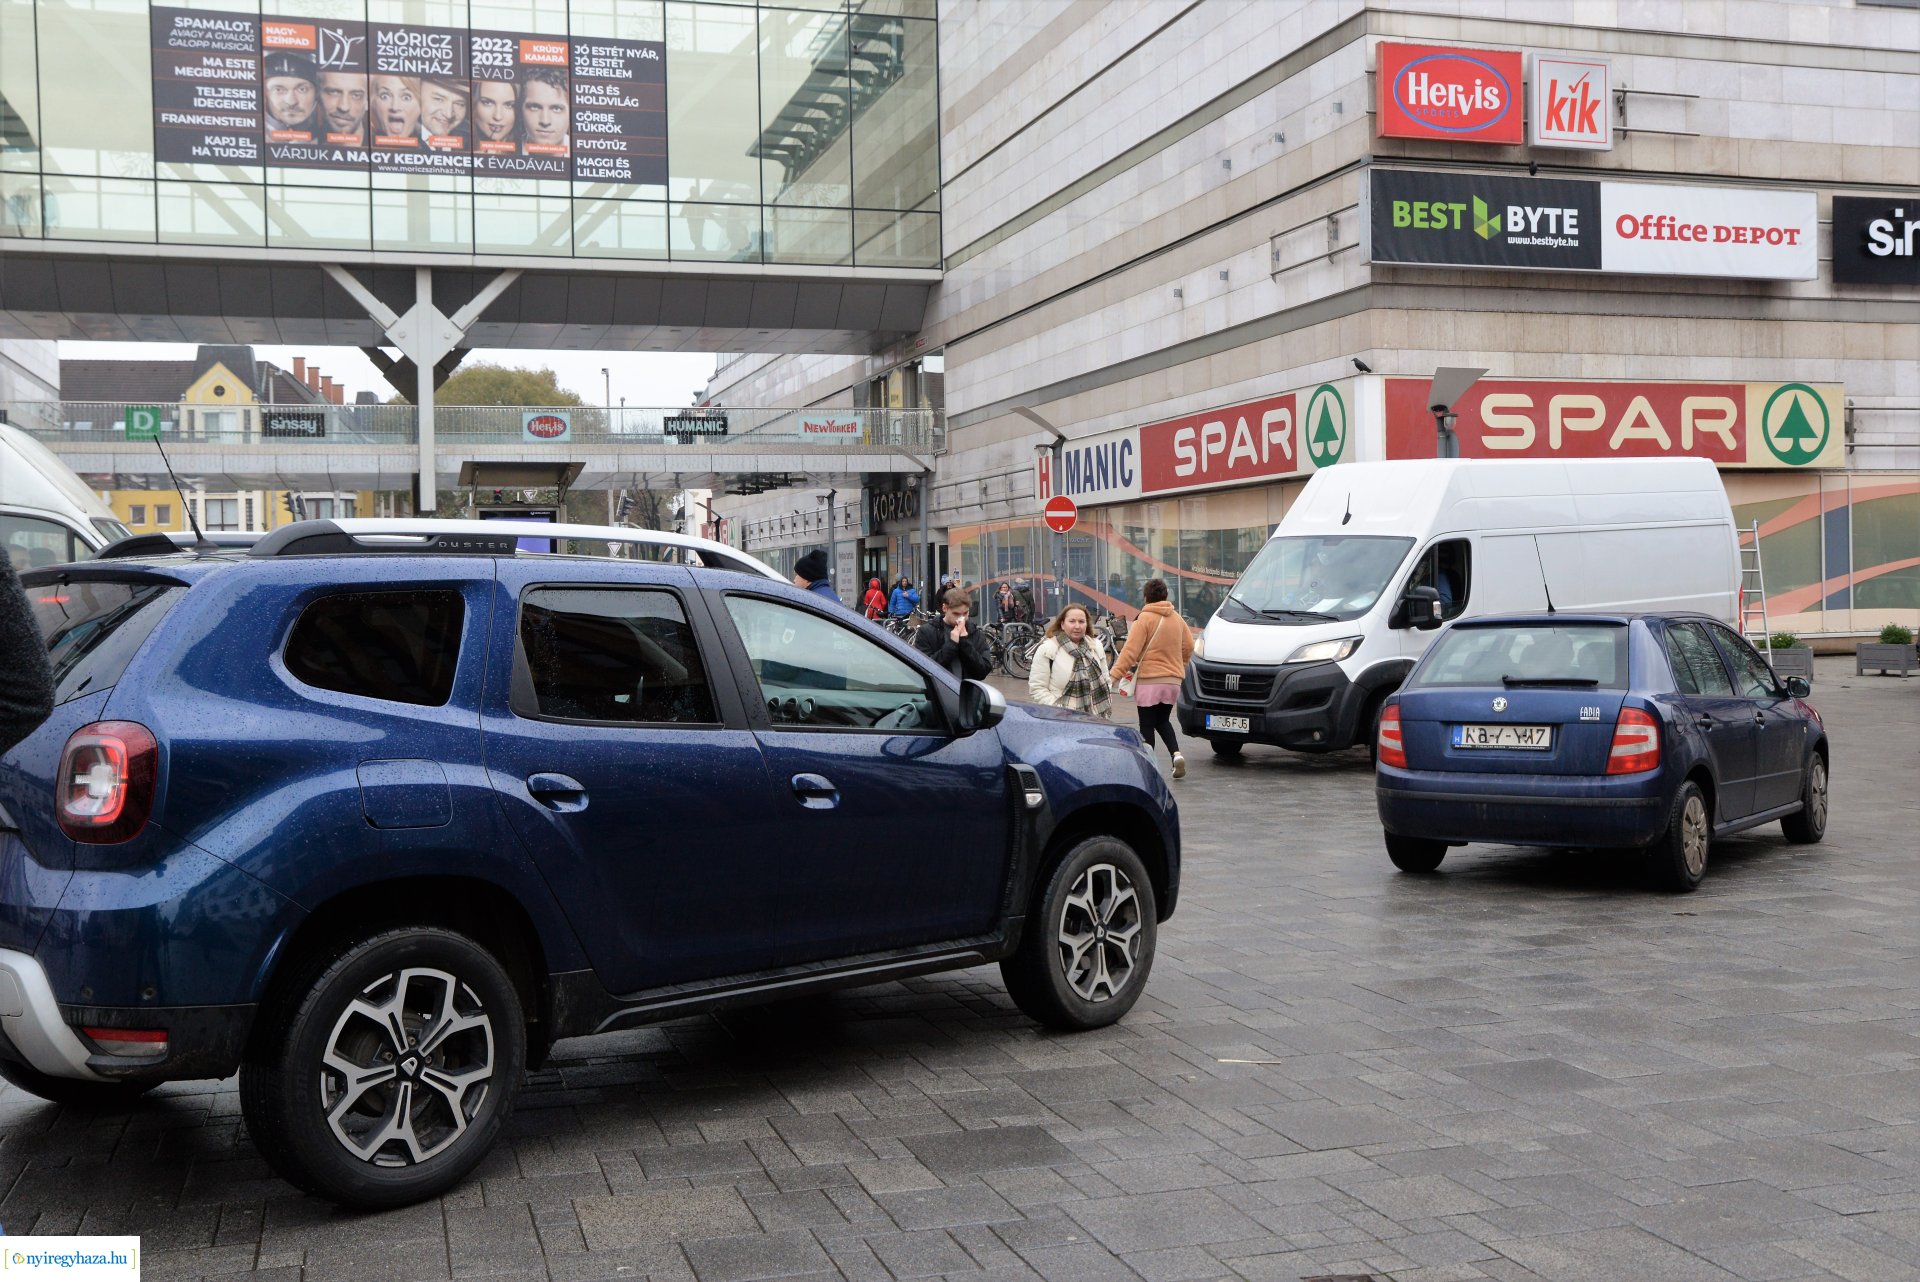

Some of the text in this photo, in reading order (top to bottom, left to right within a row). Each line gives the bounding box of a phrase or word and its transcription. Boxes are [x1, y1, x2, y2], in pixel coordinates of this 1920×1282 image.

[174, 17, 254, 32] SPAMALOT,
[266, 26, 298, 36] NAGY-
[266, 35, 310, 46] SZÍNPAD
[378, 28, 452, 48] MÓRICZ
[378, 45, 452, 59] ZSIGMOND
[472, 52, 514, 66] 2023
[525, 54, 564, 63] KAMARA
[574, 44, 659, 60] JÓ ESTÉT NYÁR,
[202, 57, 256, 70] MA ESTE
[378, 57, 452, 74] SZÍNHÁZ
[575, 56, 624, 68] JÓ ESTÉT
[175, 67, 256, 80] MEGBUKUNK
[472, 66, 514, 80] ÉVAD
[576, 67, 632, 78] SZERELEM
[196, 87, 256, 99] TELJESEN
[576, 84, 620, 96] UTAS ÉS
[1408, 71, 1500, 116] Hervis
[194, 98, 256, 110] IDEGENEK
[576, 95, 639, 108] HOLDVILÁG
[161, 113, 256, 128] FRANKENSTEIN
[576, 112, 614, 123] GÖRBE
[205, 136, 236, 147] KAPJ
[192, 146, 210, 156] HA
[270, 146, 328, 160] VÁRJUK
[332, 152, 344, 161] A
[346, 152, 391, 164] NAGY
[394, 154, 484, 168] KEDVENCEK
[577, 157, 630, 168] MAGGI ÉS
[578, 168, 632, 178] LILLEMOR
[1393, 200, 1578, 235] BEST BYTE
[1616, 214, 1800, 246] Office DEPOT
[1508, 236, 1578, 248] www.bestbyte.hu
[270, 416, 316, 434] sinsay
[668, 418, 724, 432] HUMANIC
[1480, 393, 1738, 451] SPAR
[1174, 407, 1292, 477] SPAR
[1038, 438, 1133, 500] HMANIC
[874, 490, 913, 522] KORZO
[1225, 674, 1240, 690] FIAT
[1580, 706, 1600, 717] FABIA
